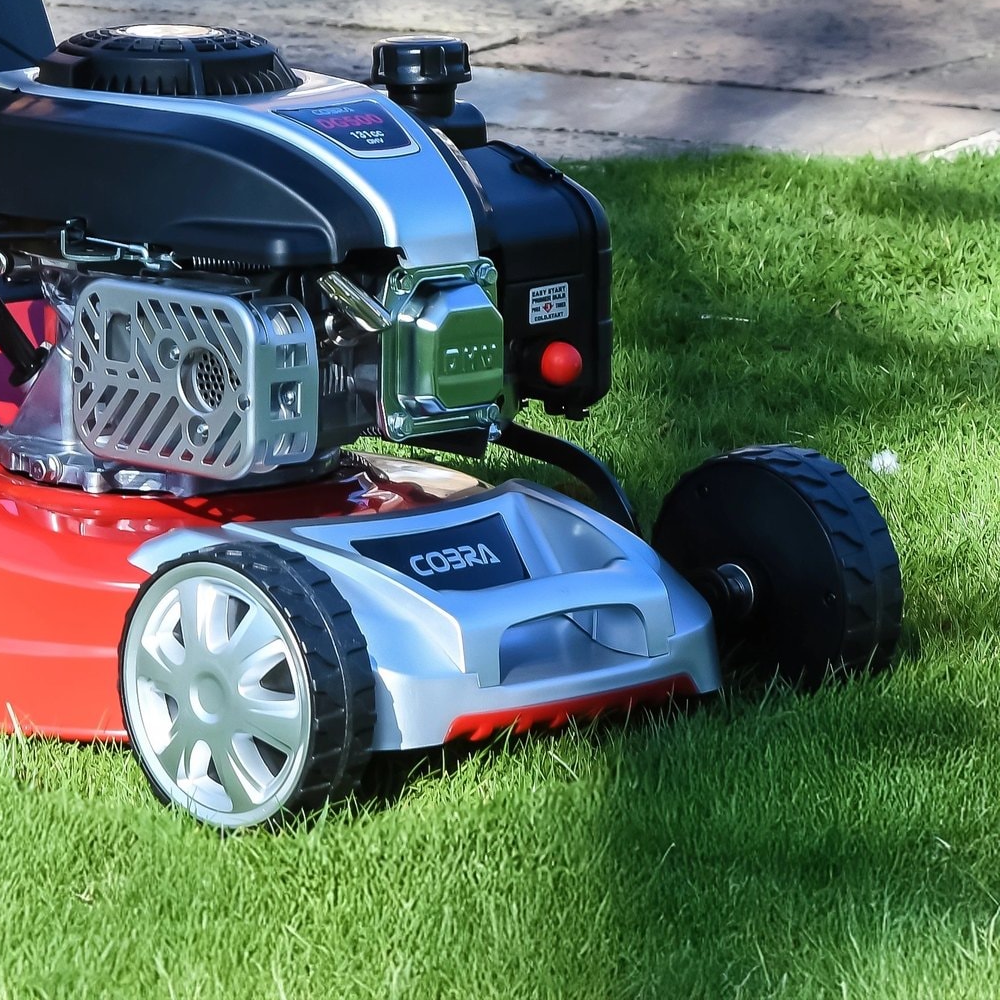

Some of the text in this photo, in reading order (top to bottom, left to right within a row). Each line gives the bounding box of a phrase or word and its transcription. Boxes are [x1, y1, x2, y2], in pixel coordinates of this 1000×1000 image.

[317, 113, 383, 129] DG500
[350, 130, 385, 139] 131cc
[548, 286, 566, 294] START
[410, 543, 500, 576] COBRA
